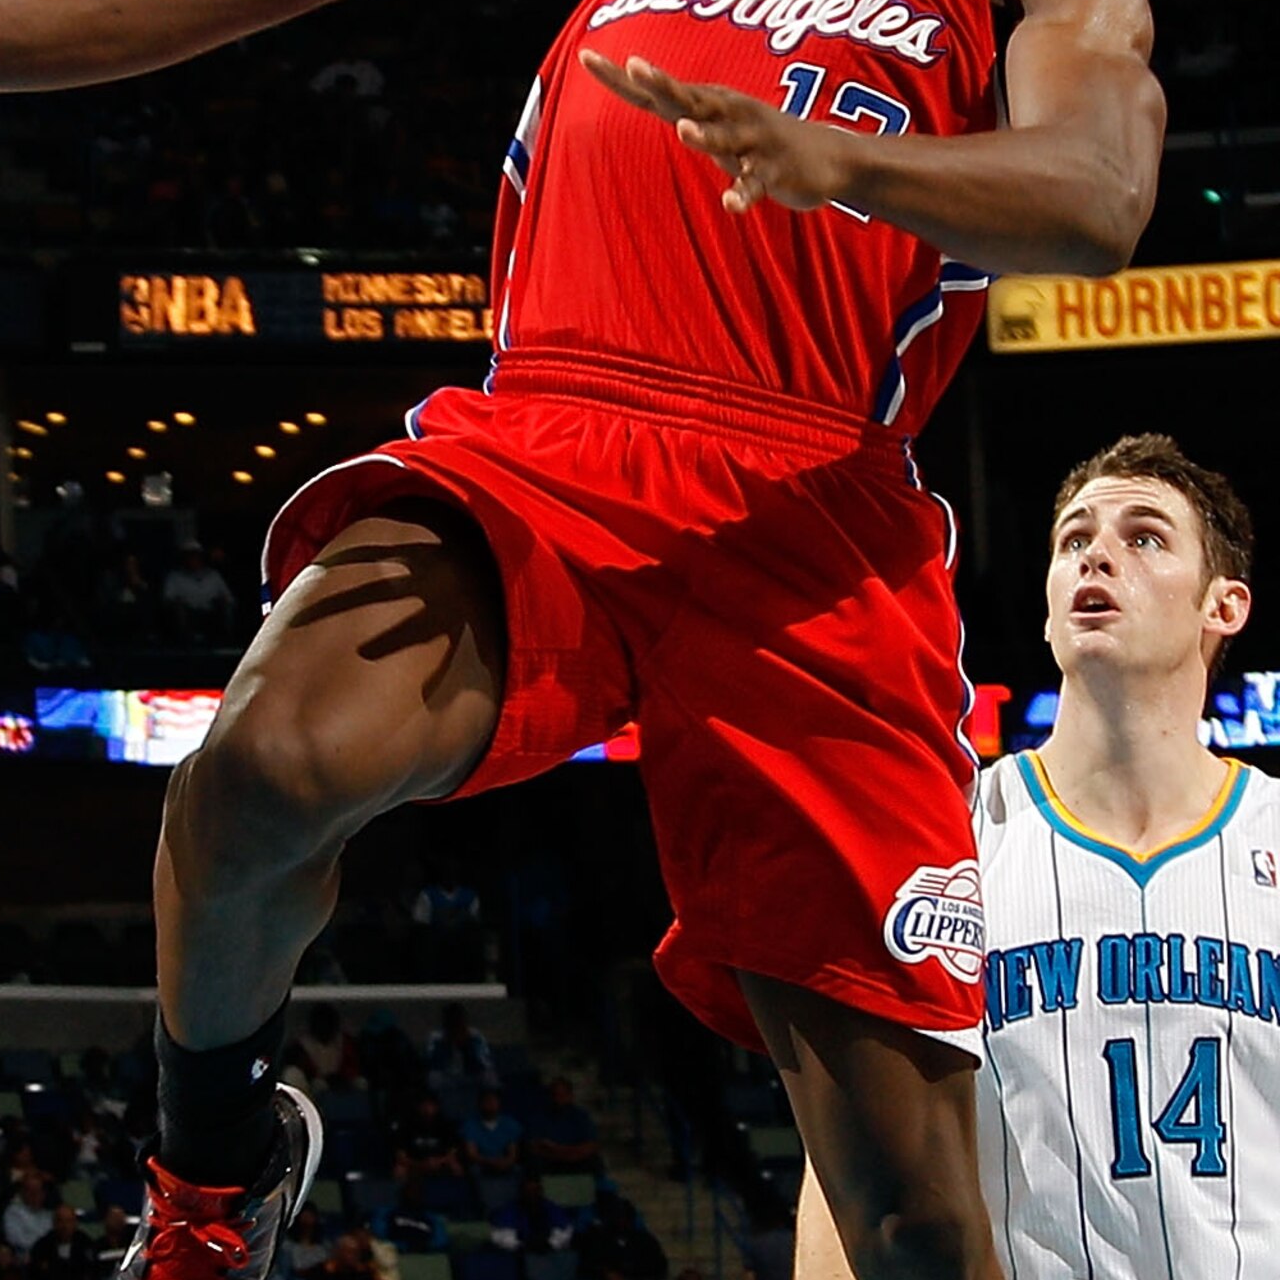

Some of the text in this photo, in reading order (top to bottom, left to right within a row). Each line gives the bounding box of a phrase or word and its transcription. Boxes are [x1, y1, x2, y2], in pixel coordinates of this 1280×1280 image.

[149, 273, 257, 335] NBA
[321, 273, 486, 304] MINNESOTA
[323, 309, 383, 340] LOS
[892, 895, 986, 955] CLIPPER
[941, 901, 961, 914] LOS
[985, 932, 1280, 1033] NEW ORLEAN
[1102, 1036, 1227, 1180] 14
